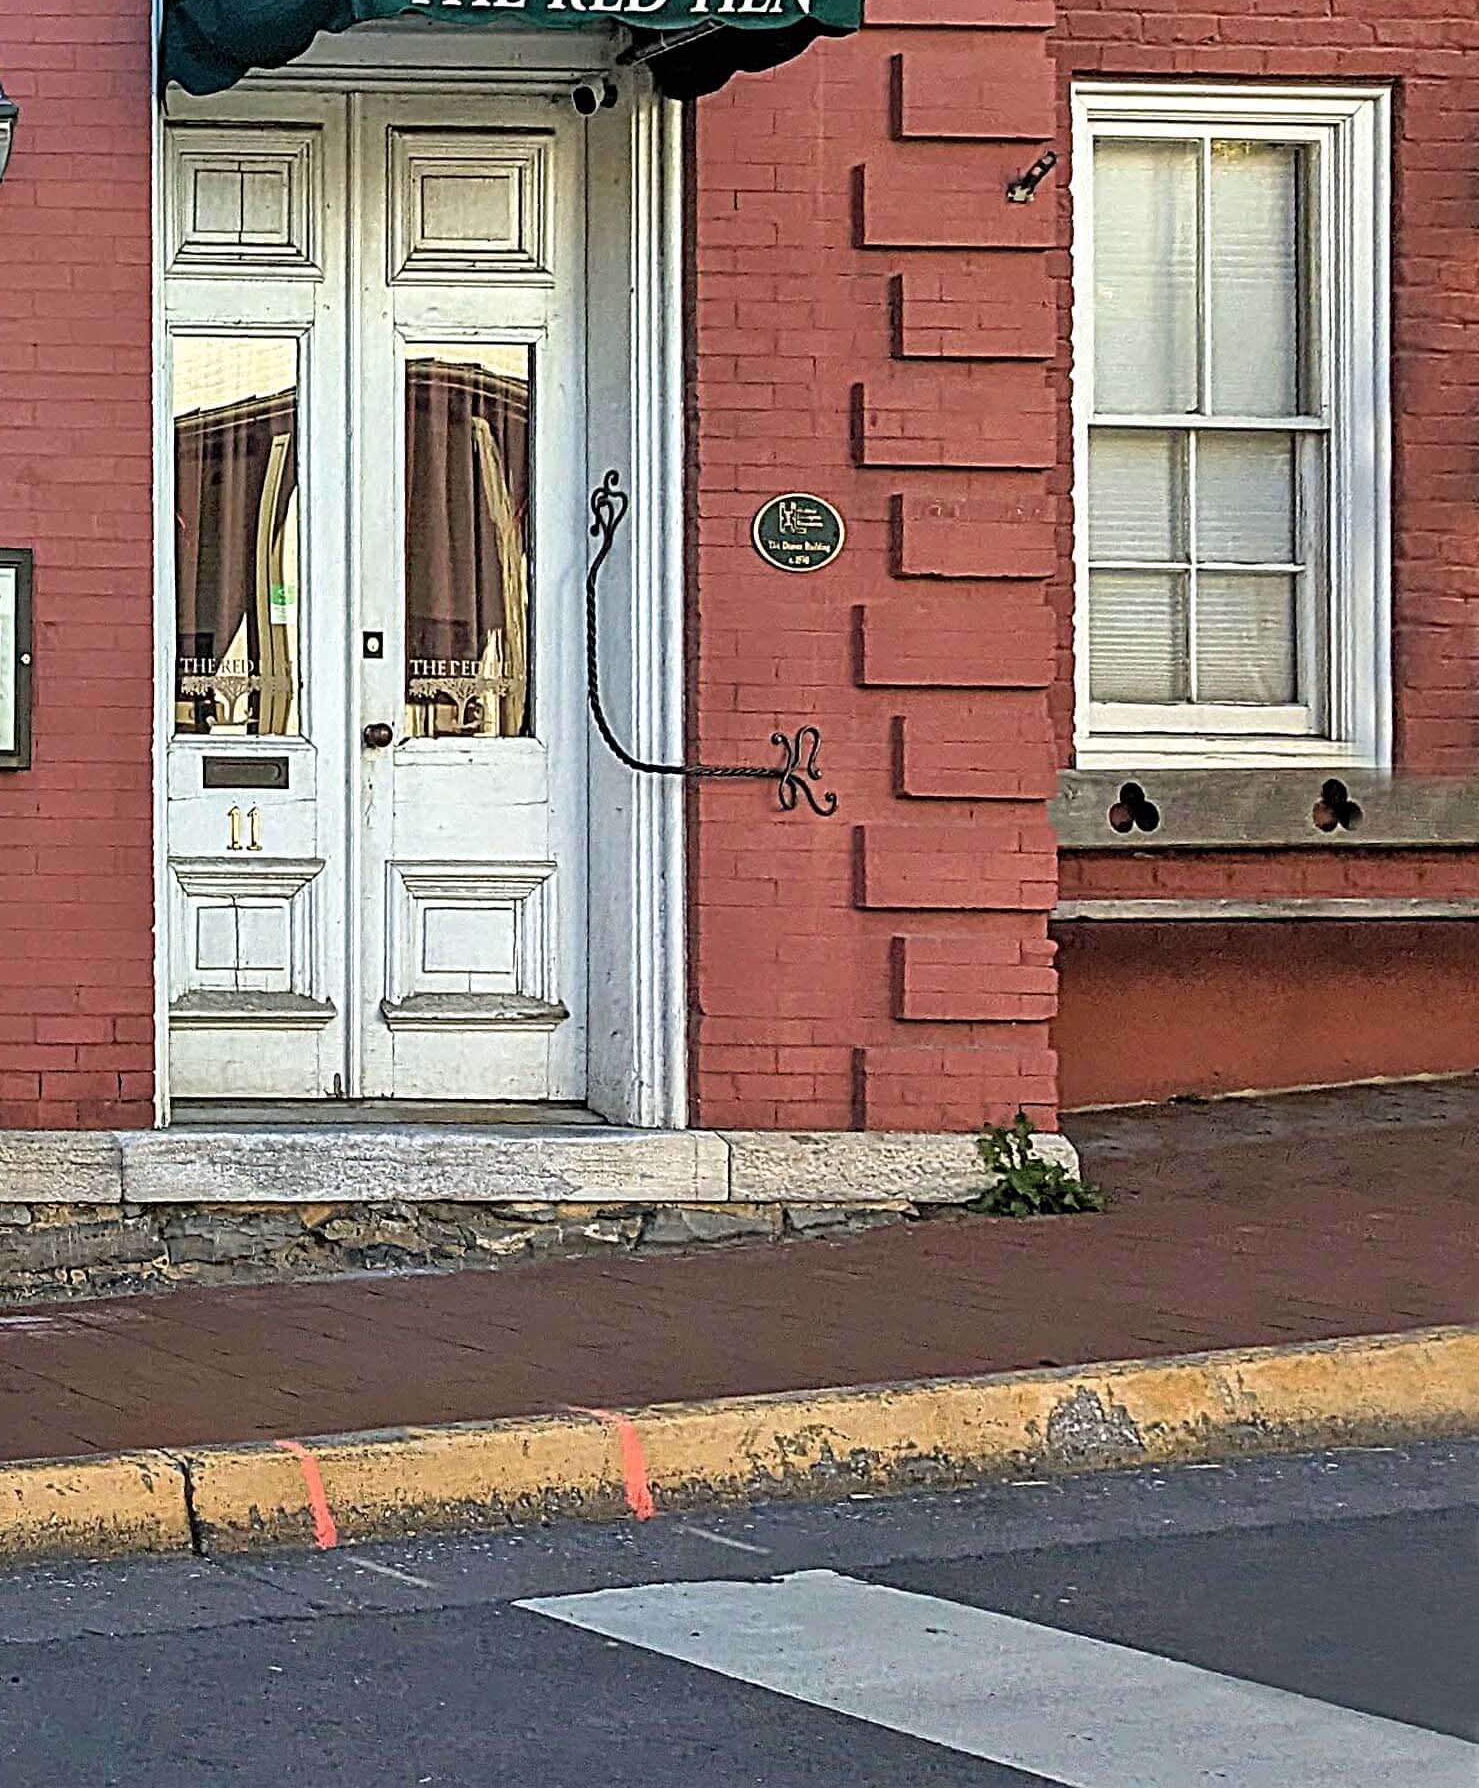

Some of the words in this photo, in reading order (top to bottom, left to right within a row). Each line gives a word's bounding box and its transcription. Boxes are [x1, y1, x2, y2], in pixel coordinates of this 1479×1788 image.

[180, 658, 216, 673] THE
[222, 659, 255, 674] RED
[410, 659, 446, 676] THE
[226, 805, 263, 852] 11
